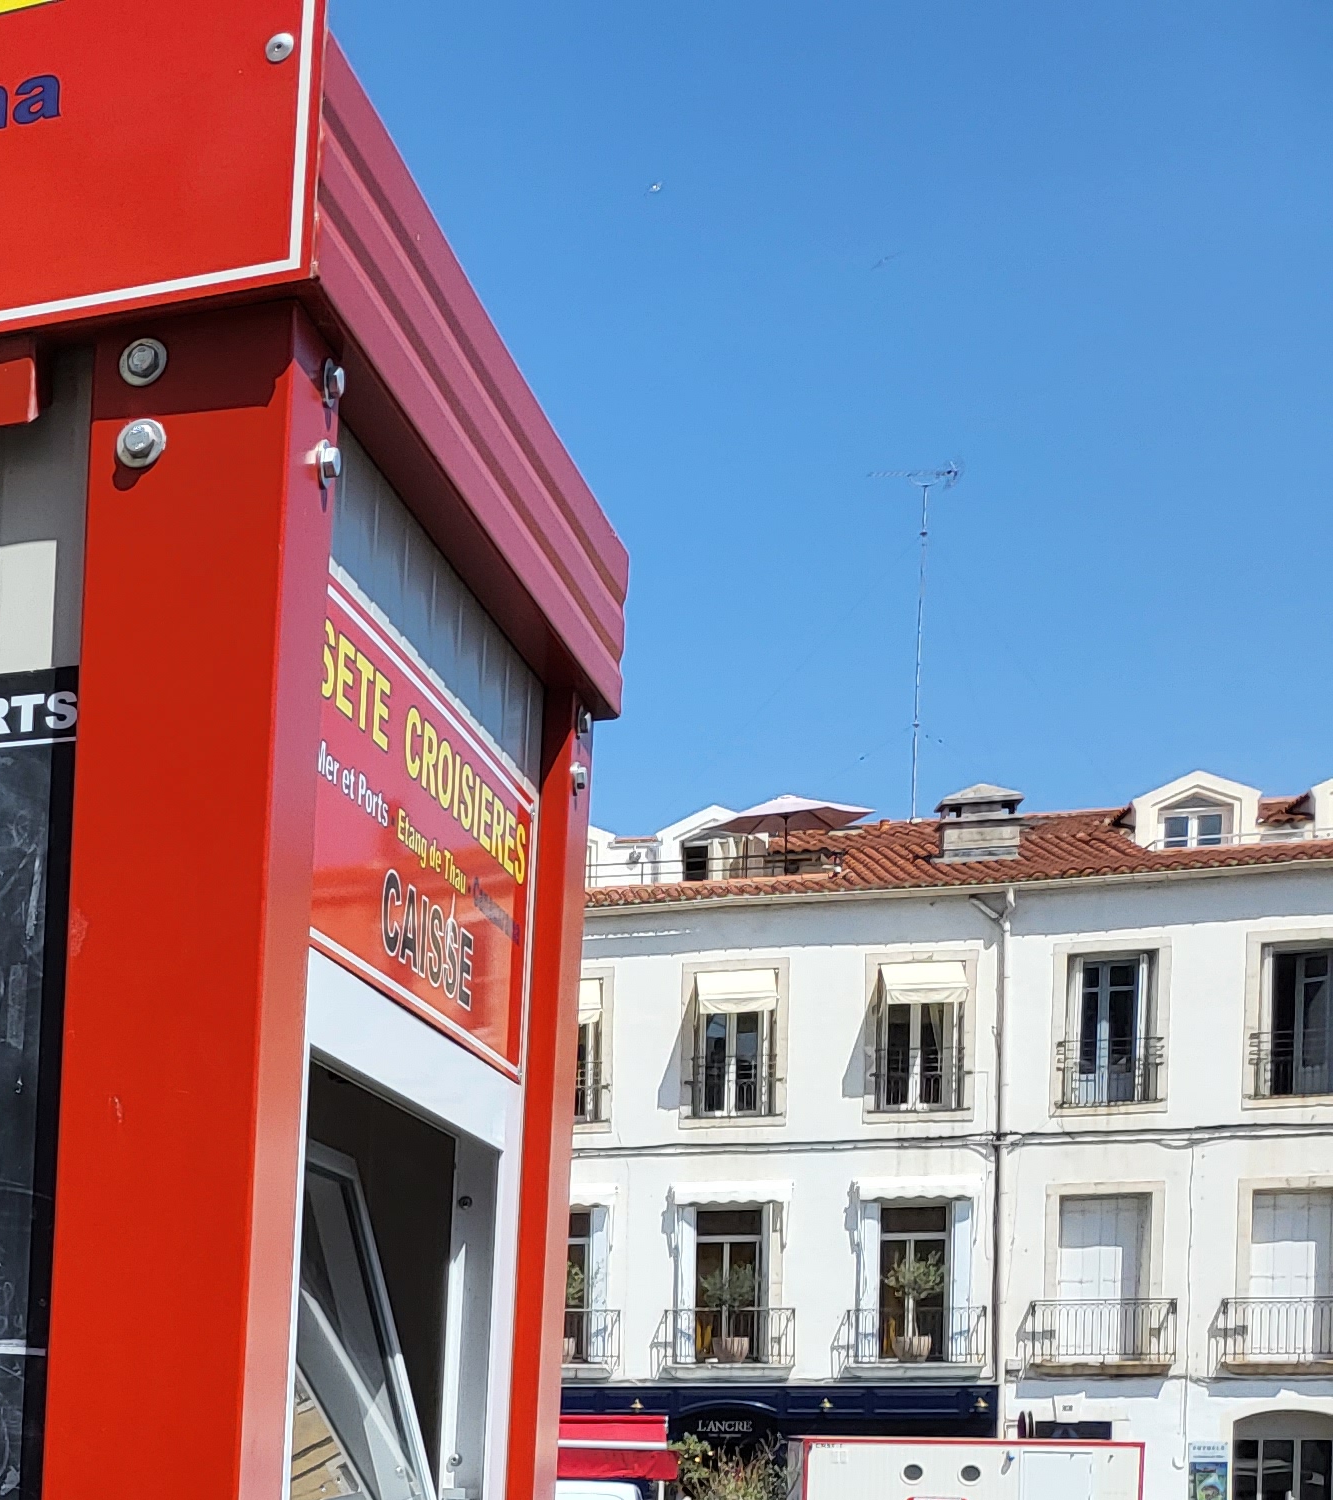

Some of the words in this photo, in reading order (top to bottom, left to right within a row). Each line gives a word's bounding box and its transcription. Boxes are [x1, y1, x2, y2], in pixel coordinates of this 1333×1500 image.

[341, 765, 355, 800] et
[357, 770, 390, 828] Ports
[397, 807, 427, 869] Etang
[429, 838, 442, 873] de
[444, 849, 467, 895] Thau
[404, 705, 527, 886] CROISIERES
[381, 868, 475, 1012] CAISSE
